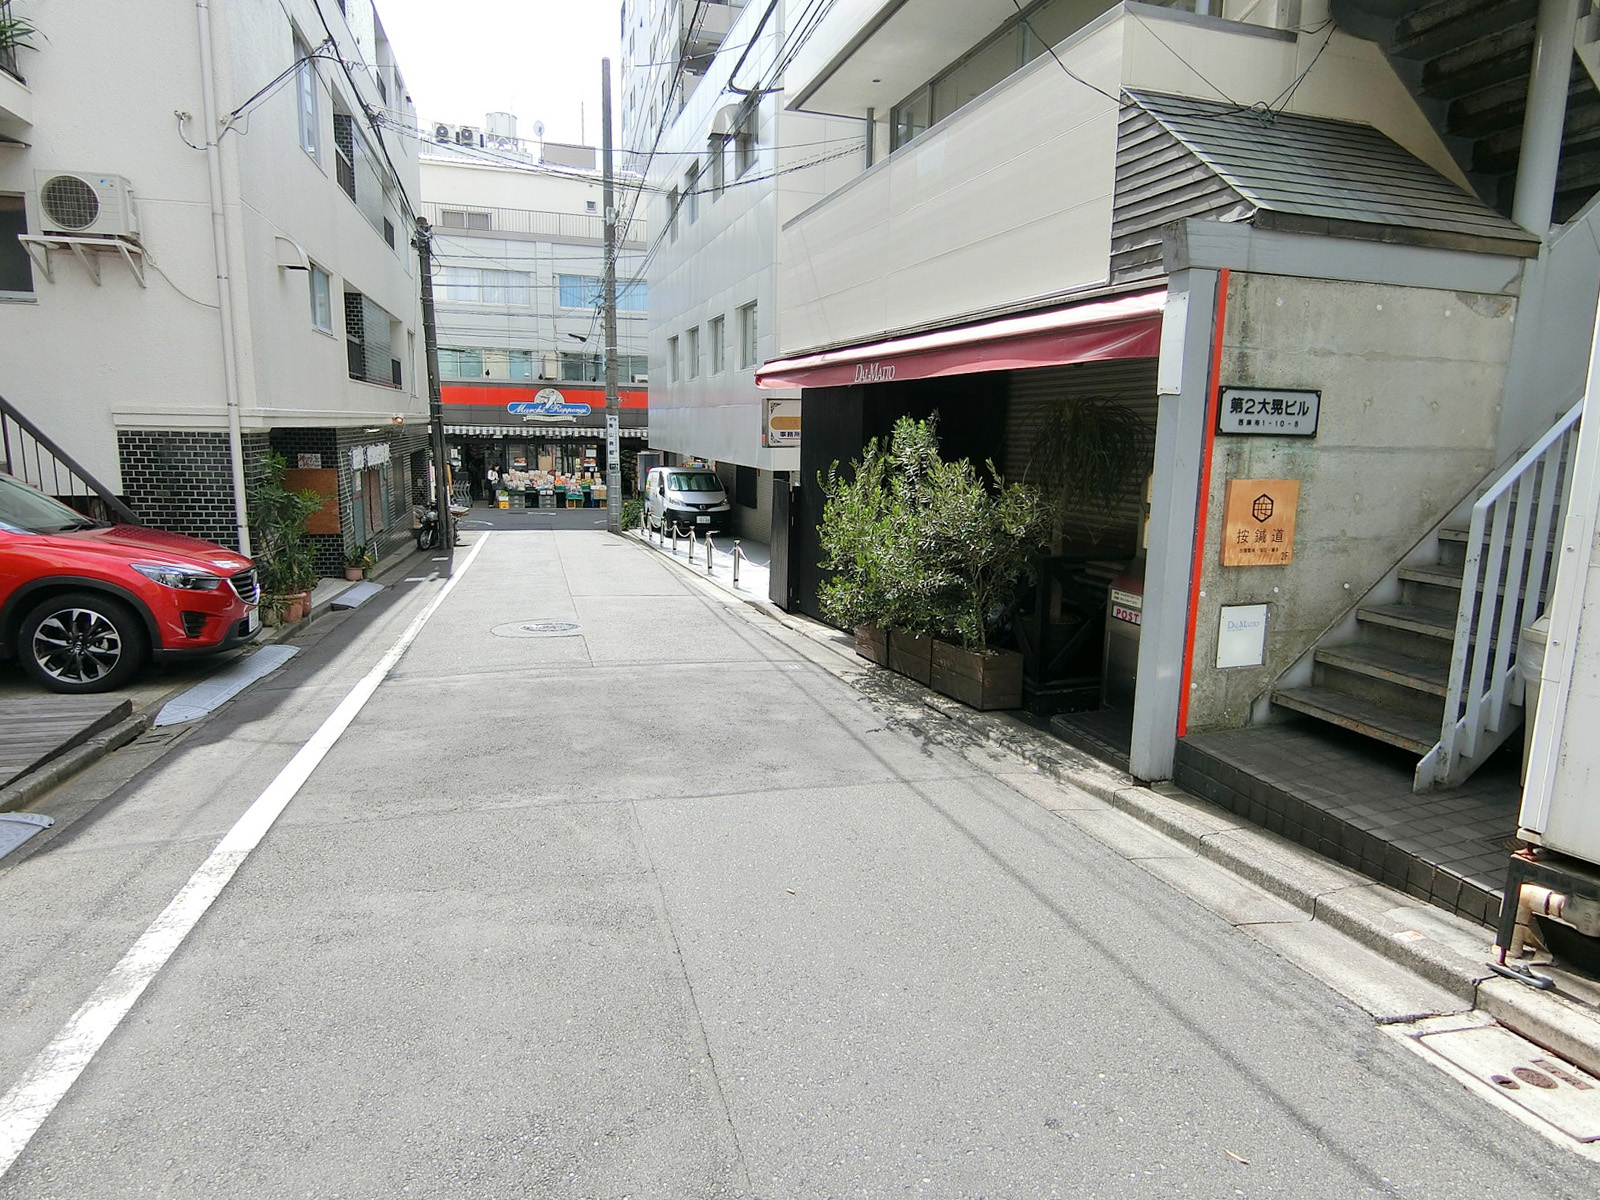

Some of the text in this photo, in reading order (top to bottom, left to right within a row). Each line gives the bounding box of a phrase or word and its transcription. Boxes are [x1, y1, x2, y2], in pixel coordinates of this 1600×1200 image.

[549, 405, 589, 414] Roppongi
[1230, 397, 1310, 416] 第2大晃ビル
[1115, 608, 1140, 623] POST
